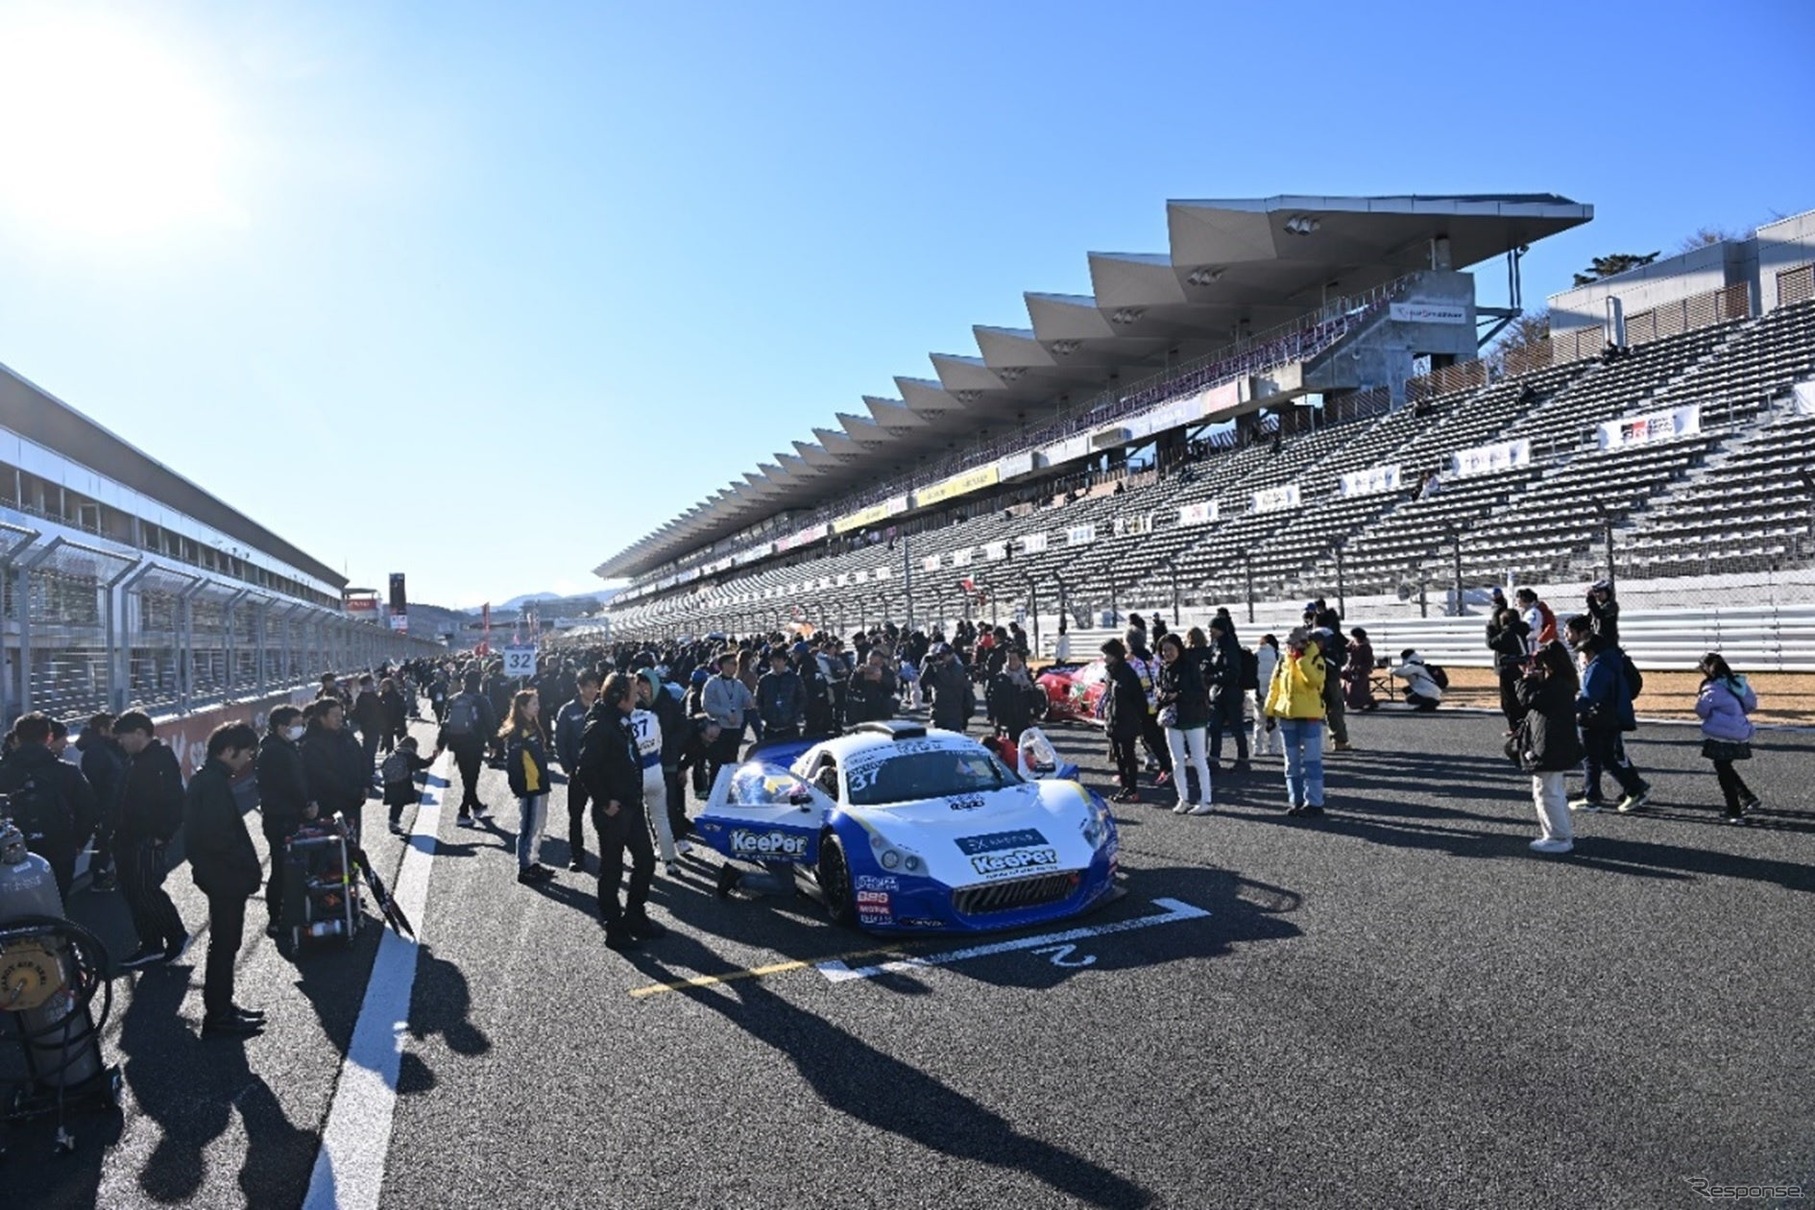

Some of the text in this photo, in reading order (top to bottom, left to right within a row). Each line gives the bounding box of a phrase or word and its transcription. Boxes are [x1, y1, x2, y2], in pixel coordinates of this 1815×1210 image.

[509, 653, 531, 668] 32
[849, 767, 880, 791] 37
[730, 829, 808, 854] KeePer
[971, 848, 1058, 875] KeePer
[1031, 944, 1097, 967] 2
